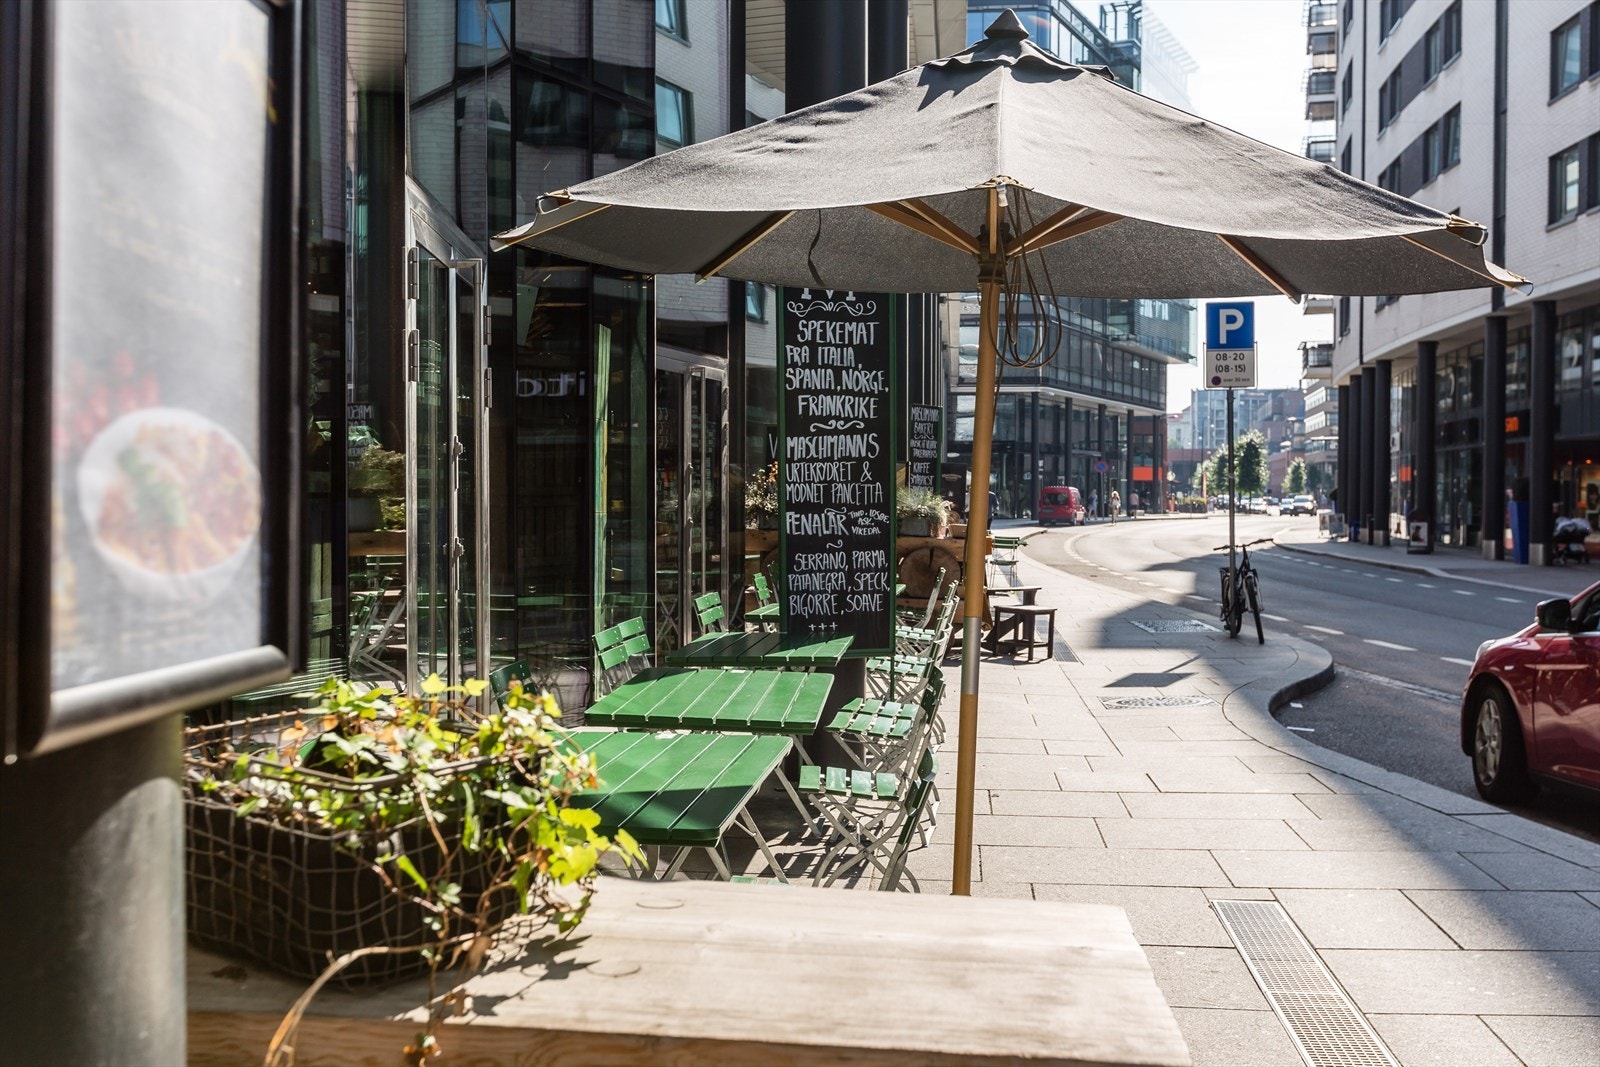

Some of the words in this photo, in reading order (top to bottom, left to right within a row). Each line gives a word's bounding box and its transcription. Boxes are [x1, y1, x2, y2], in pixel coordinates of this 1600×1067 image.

[797, 320, 879, 345] SPEKEMAT
[1219, 308, 1244, 345] P
[785, 344, 810, 366] FRA
[818, 346, 863, 370] ITALIA,
[1215, 364, 1246, 373] (08-15)
[798, 394, 879, 419] FRANKRIKE
[786, 433, 879, 461] MASCHMANNS
[786, 462, 856, 482] URTEKRYDRET
[861, 461, 873, 482] &
[913, 462, 931, 474] KAFFE
[785, 483, 828, 504] MODNET
[830, 482, 883, 506] PANCETTA
[851, 526, 882, 536] VIKEDAL
[793, 551, 849, 572] SERRANO,
[852, 550, 888, 569] PARMA,
[788, 571, 852, 594] PATANEGRA,
[853, 572, 890, 592] SPECK,
[789, 593, 845, 619] BIGORRE,
[845, 593, 884, 612] SOAVE
